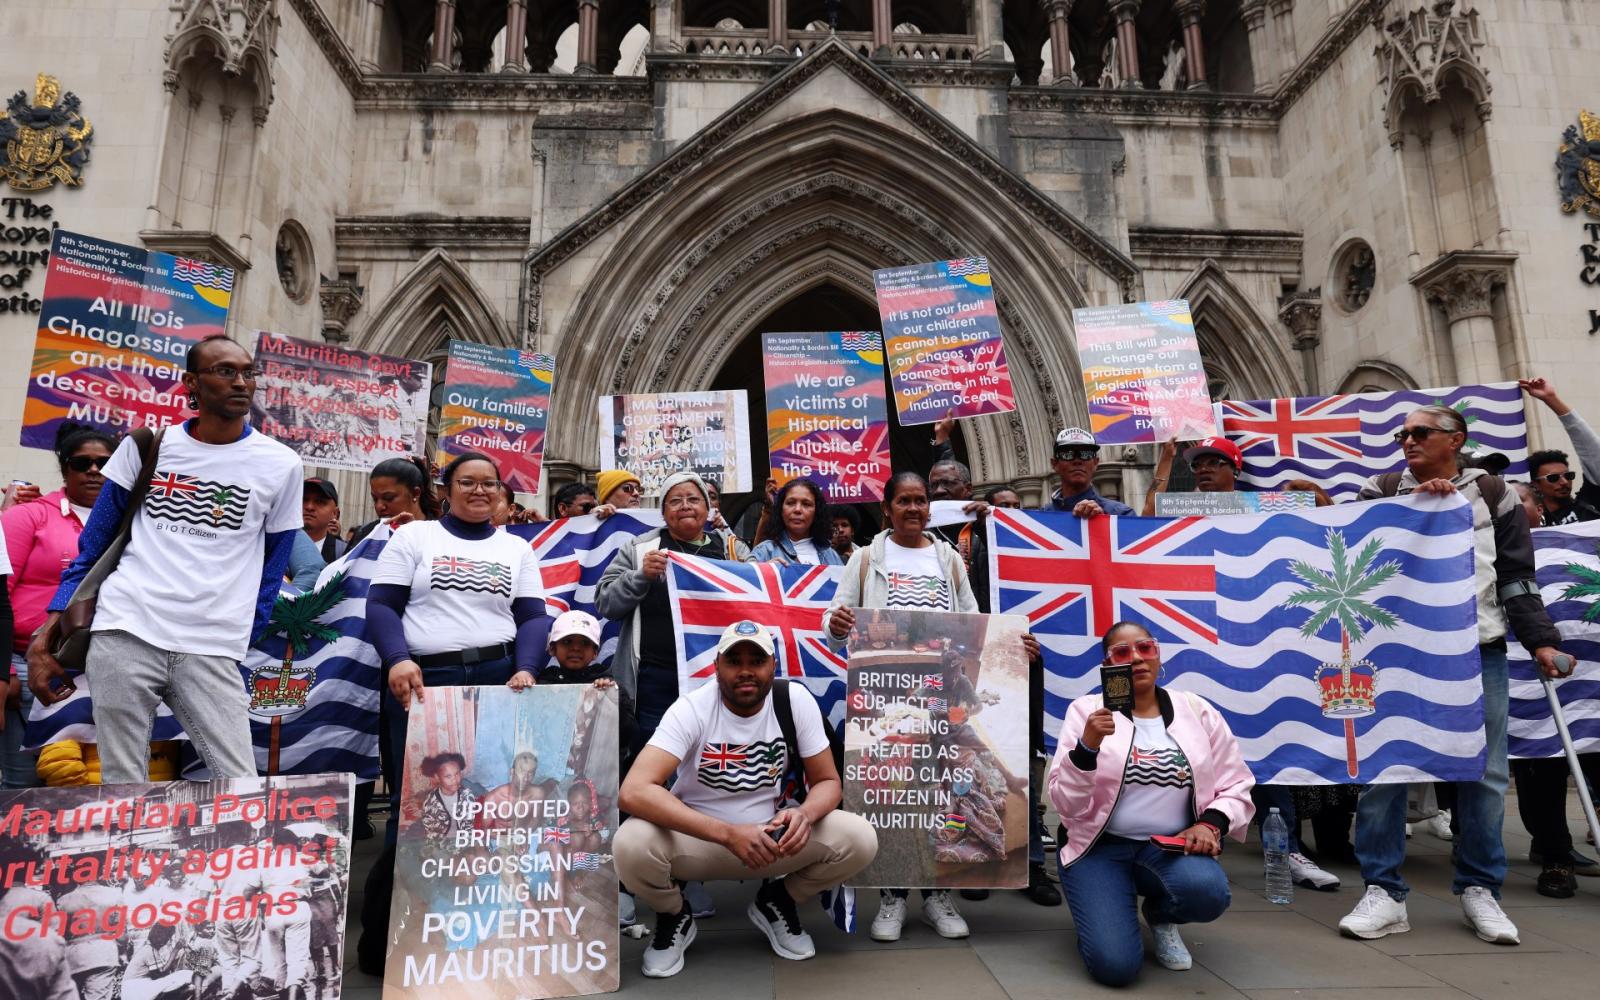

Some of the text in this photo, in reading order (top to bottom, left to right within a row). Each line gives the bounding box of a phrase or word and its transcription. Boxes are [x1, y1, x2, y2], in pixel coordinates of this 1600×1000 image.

[2, 198, 53, 218] The
[61, 237, 75, 246] 8th
[59, 246, 169, 277] Nationality & Borders Bill
[65, 257, 116, 275] Citizenship
[0, 267, 32, 289] of
[56, 265, 195, 301] Historical Legislative Unfairness
[88, 297, 184, 330] All Illois
[889, 300, 984, 322] It is not our fault
[48, 316, 192, 357] Chagossia
[903, 317, 976, 336] our children
[894, 330, 990, 351] cannot be born
[1090, 336, 1188, 352] This Bill will only
[262, 335, 412, 378] Mauritian Govt
[897, 345, 994, 366] on Chagos, you
[1103, 350, 1178, 364] change our
[70, 351, 187, 382] and their
[899, 360, 996, 382] banned us from
[1091, 361, 1197, 380] problems from a
[36, 370, 188, 409] descendan
[266, 361, 399, 398] Don't respect
[795, 373, 855, 388] We are
[903, 374, 999, 397] our home in the
[1095, 378, 1161, 392] legislative
[266, 387, 398, 421] Chagossians
[449, 393, 543, 418] Our families
[632, 397, 713, 412] MAURITIAN
[785, 393, 869, 410] victims of
[909, 390, 999, 412] Indian Ocean!
[1121, 395, 1130, 403] a
[1134, 388, 1206, 401] FINANCIAL
[66, 402, 137, 427] MUST
[462, 415, 526, 434] must be
[623, 411, 722, 428] GOVERNMENT
[788, 416, 868, 433] Historical
[1135, 418, 1173, 429] FIX IT!
[261, 417, 406, 454] Human rights
[456, 434, 527, 453] reunited!
[683, 427, 713, 440] OUR
[618, 440, 735, 457] COMPENSATION
[791, 438, 868, 458] Injustice.
[618, 456, 736, 471] MADE US LIVE IN
[781, 461, 880, 477] The UK can
[828, 483, 862, 498] this!
[1162, 507, 1203, 516] Nationality
[189, 527, 217, 539] Citizen
[859, 672, 923, 689] BRITISH
[853, 694, 927, 711] SUBJECT
[861, 744, 960, 759] TREATED AS
[846, 765, 974, 783] SECOND CLASS
[863, 789, 951, 806] CITIZEN IN
[0, 796, 198, 837] Mauritian
[213, 790, 337, 823] Police
[452, 799, 570, 821] UPROOTED
[455, 827, 543, 848] BRITISH
[0, 836, 337, 889] rutality against
[421, 852, 571, 878] CHAGOSSIAN
[454, 881, 560, 906] LIVING IN
[3, 889, 299, 942] Chagossians
[422, 906, 585, 944] POVERTY
[403, 940, 607, 987] MAURITIUS
